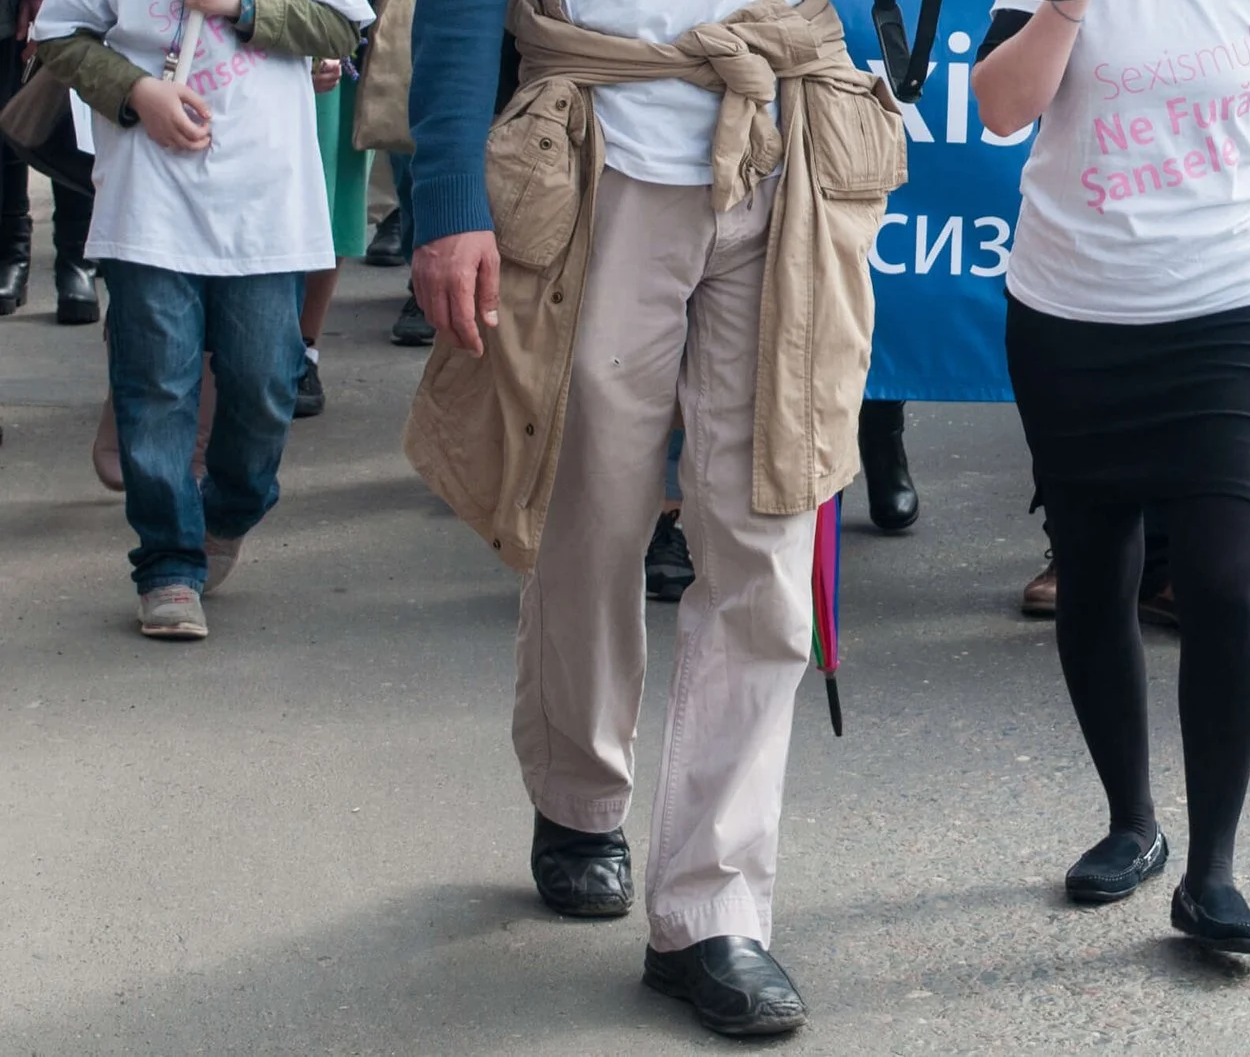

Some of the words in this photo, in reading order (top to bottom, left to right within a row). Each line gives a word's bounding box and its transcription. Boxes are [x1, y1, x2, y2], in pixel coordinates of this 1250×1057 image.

[1093, 112, 1154, 155] Ne
[1081, 136, 1241, 215] Șansele
[867, 212, 1011, 278] сиз
